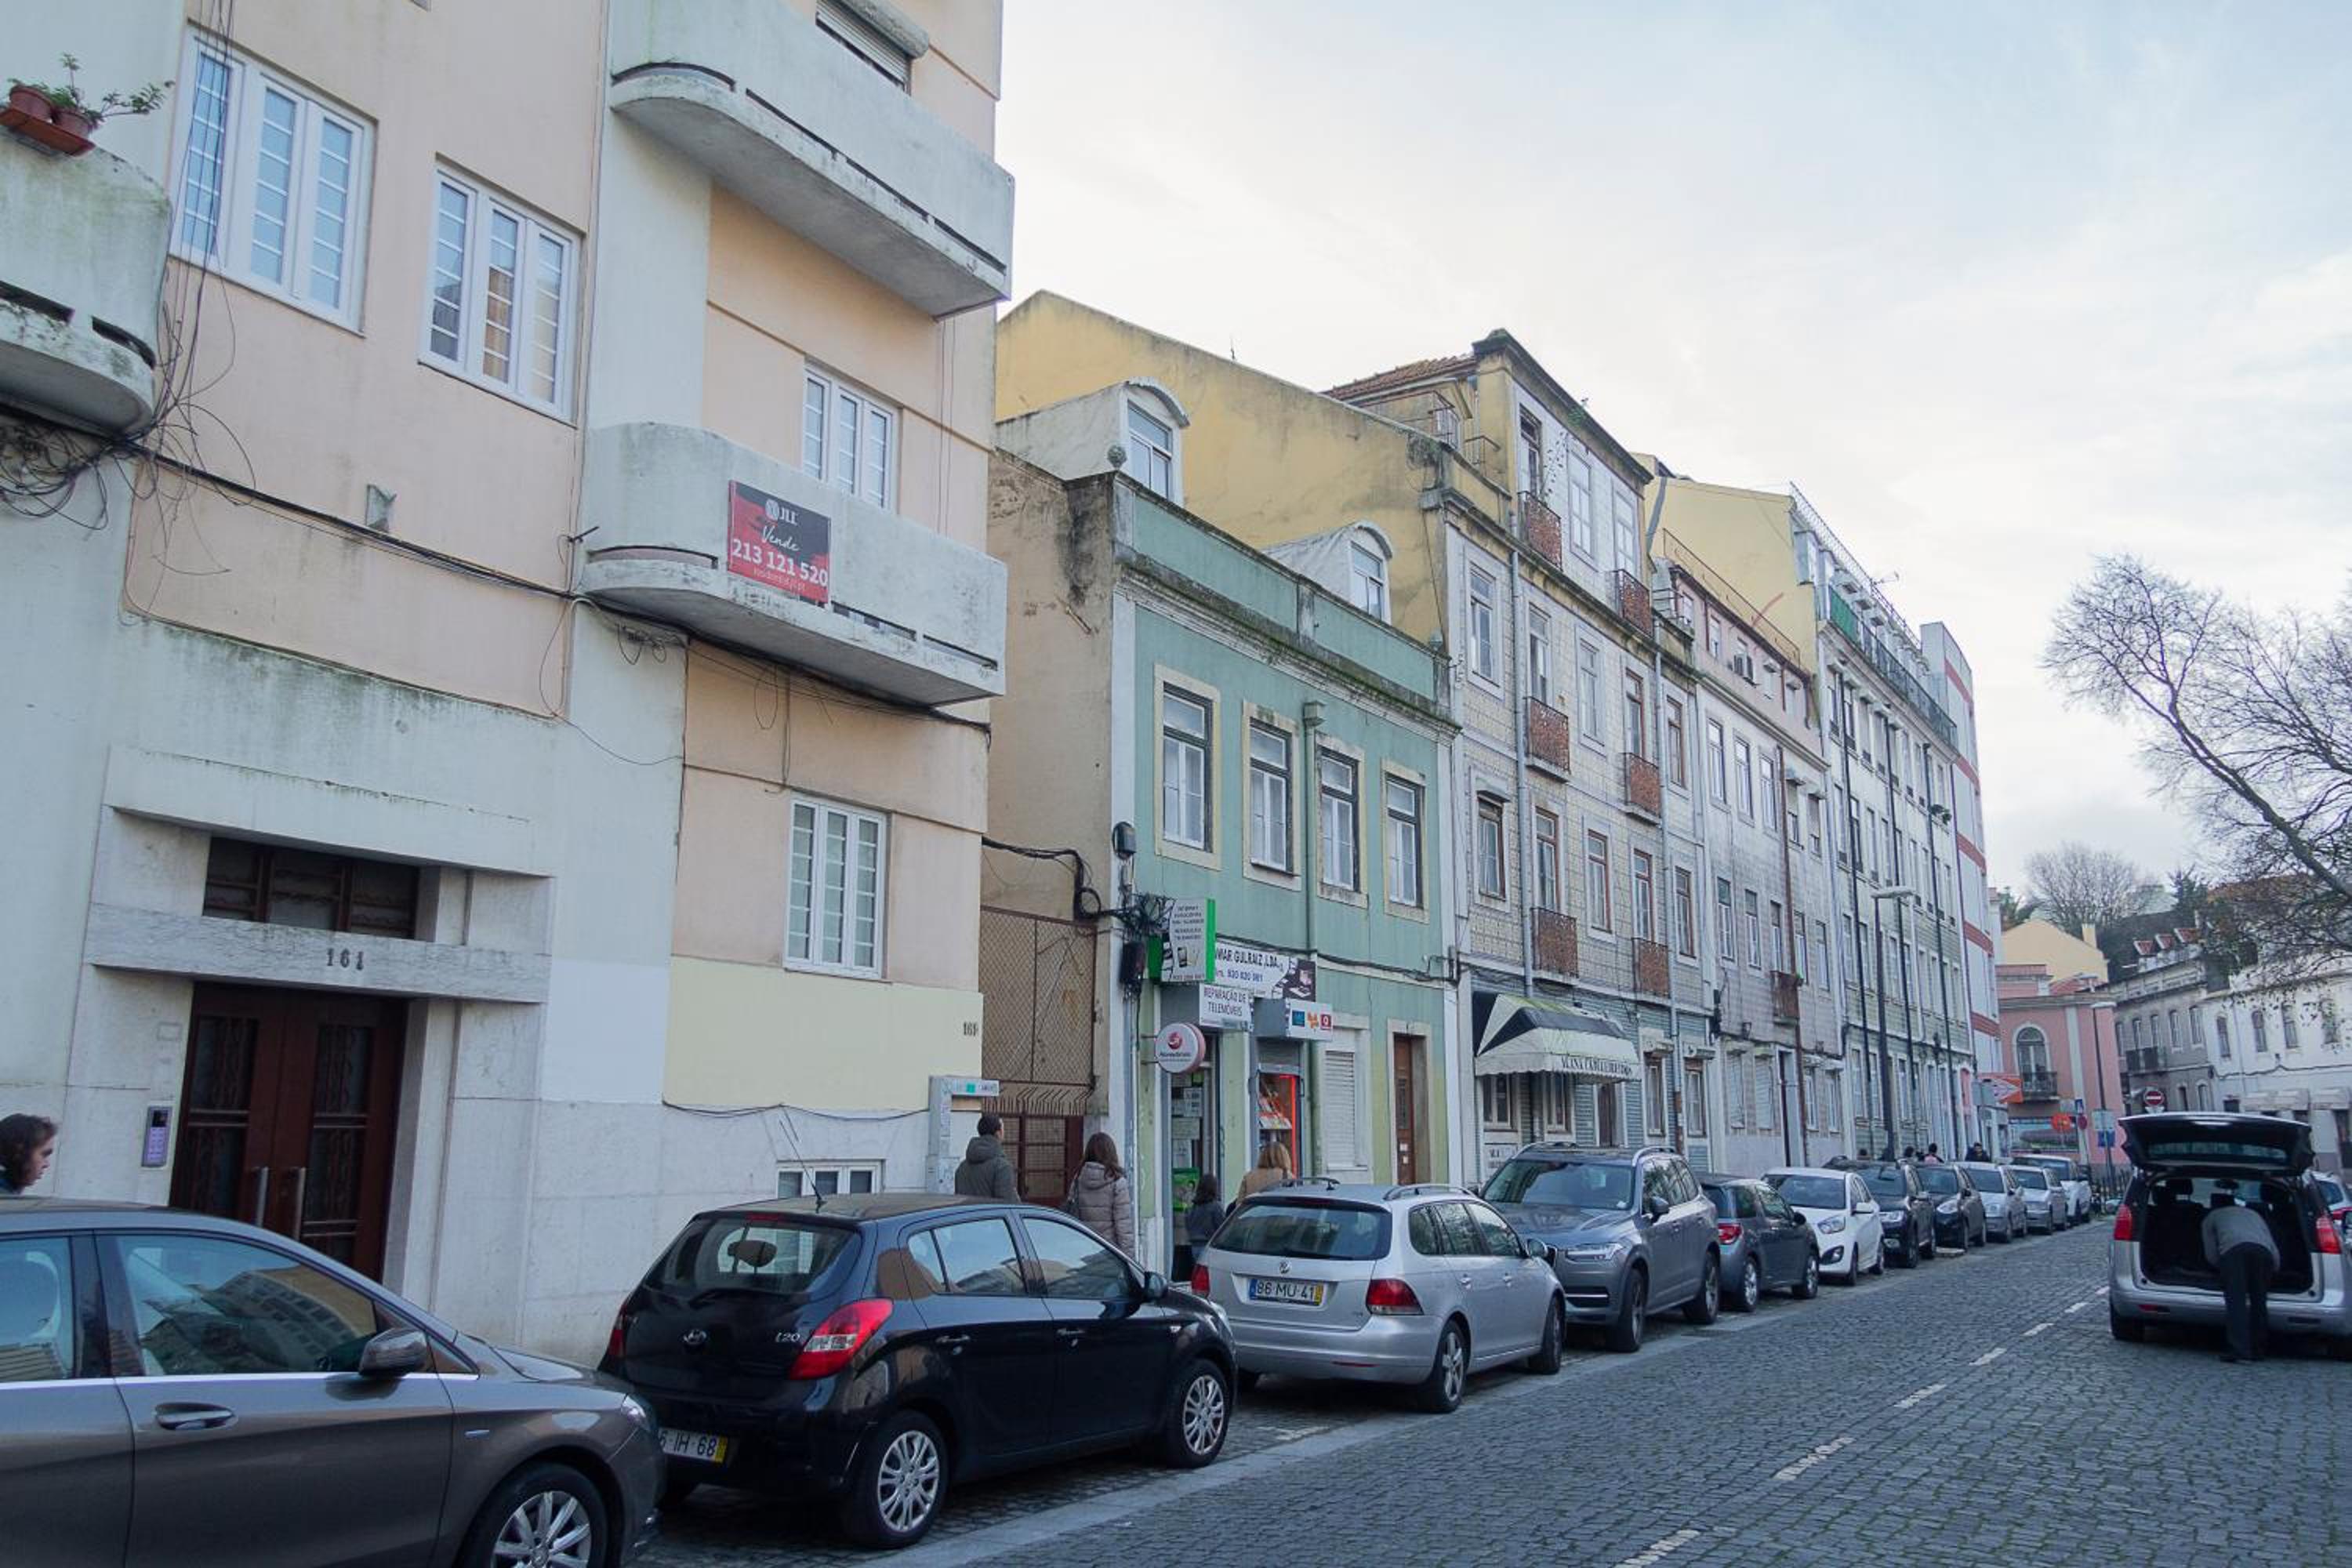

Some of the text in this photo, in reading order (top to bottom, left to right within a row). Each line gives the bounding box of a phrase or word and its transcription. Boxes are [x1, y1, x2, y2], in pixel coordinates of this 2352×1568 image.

[761, 524, 800, 551] Vende
[732, 538, 763, 564] 213
[767, 551, 796, 577] 121
[800, 561, 829, 587] 520
